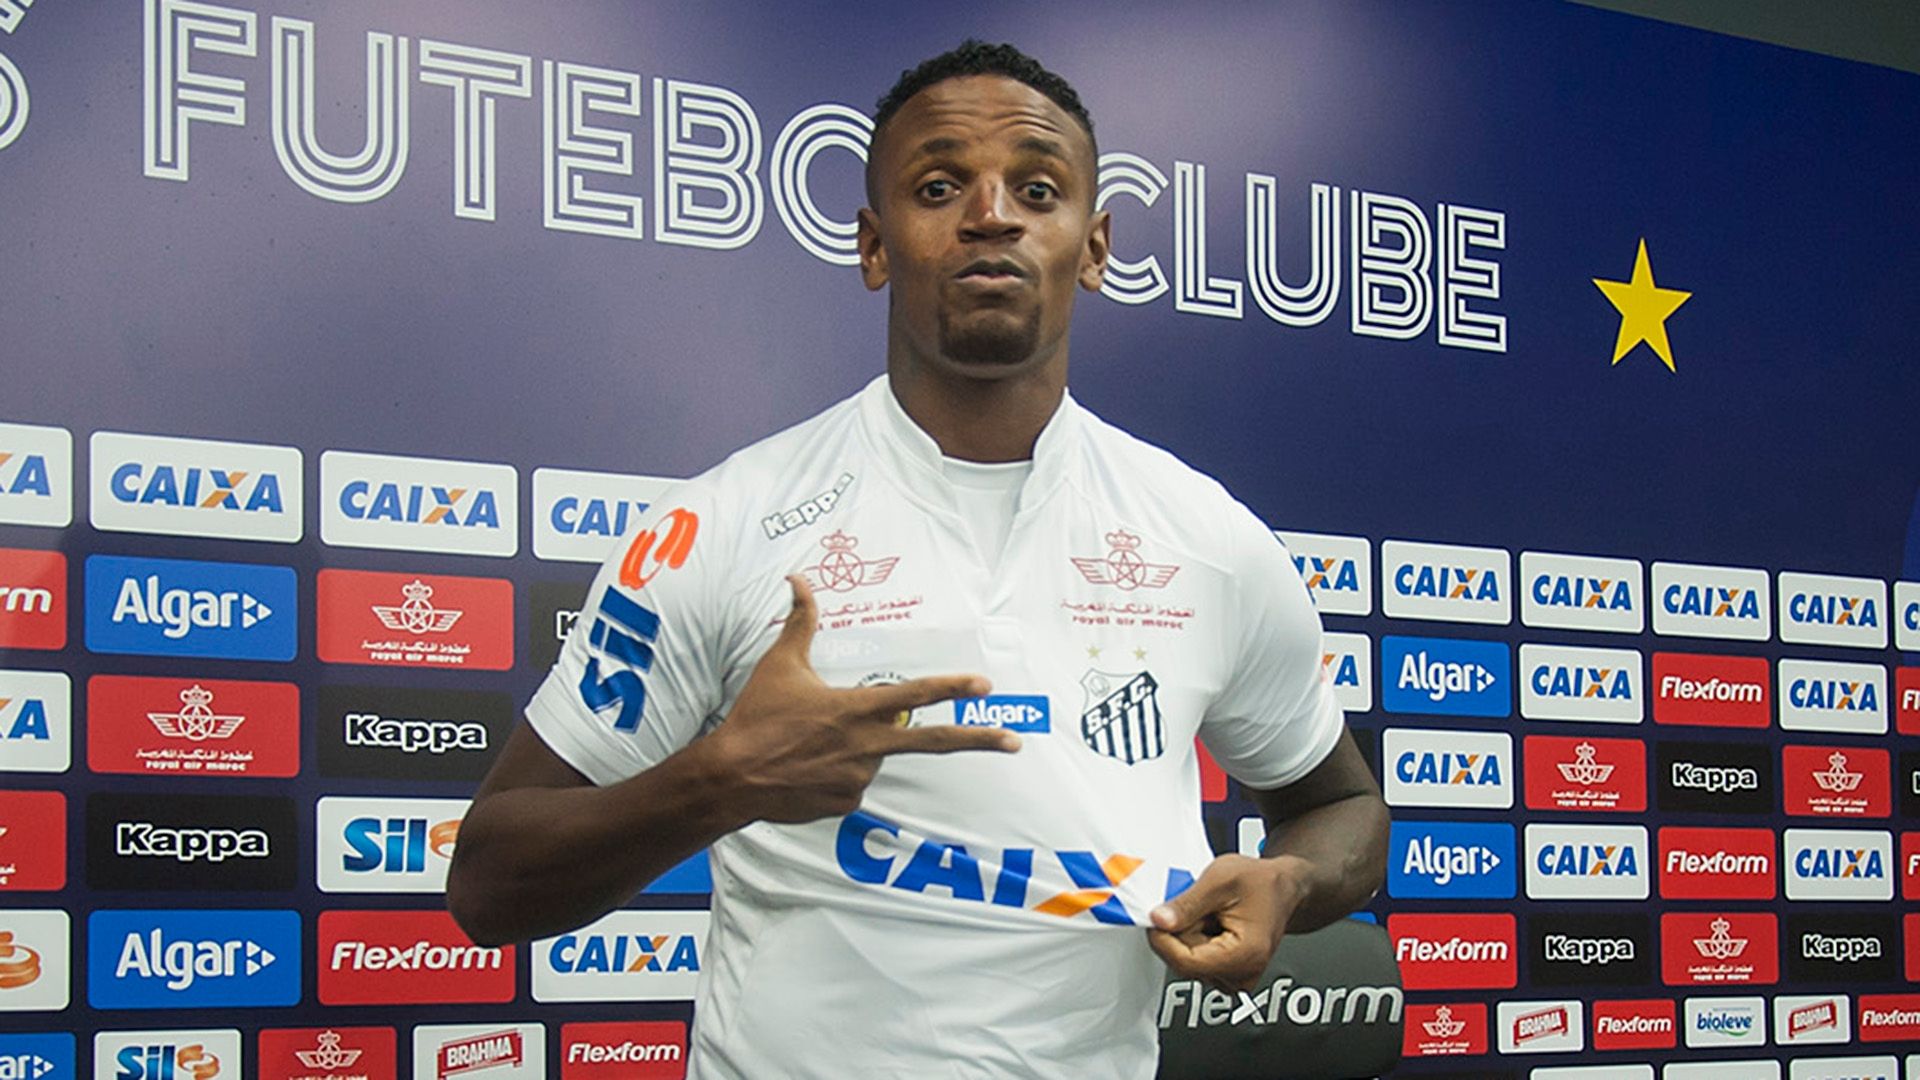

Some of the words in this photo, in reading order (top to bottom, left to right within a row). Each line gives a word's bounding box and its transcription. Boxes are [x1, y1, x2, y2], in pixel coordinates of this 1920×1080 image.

[144, 0, 876, 266] FUTEBO
[1097, 152, 1507, 353] CLUBE
[111, 463, 283, 513] CAIXA
[339, 480, 499, 529] CAIXA
[551, 497, 649, 537] CAI
[1395, 564, 1500, 602] CAIXA
[1532, 574, 1632, 611] CAIXA
[112, 575, 239, 638] Algar
[1663, 584, 1760, 619] CAIXA
[1789, 593, 1878, 628] CAIXA
[579, 584, 661, 734] Sil
[1398, 651, 1473, 701] Algar
[1532, 665, 1632, 700] CAIXA
[1661, 676, 1762, 702] Flexform
[1789, 679, 1878, 712] CAIXA
[961, 699, 1026, 728] Algar
[345, 714, 488, 754] Kappa
[1396, 751, 1502, 786] CAIXA
[1672, 762, 1758, 793] Kappa
[116, 823, 270, 862] Kappa
[343, 818, 427, 873] Sil
[1403, 836, 1480, 885] Algar
[1537, 844, 1639, 877] CAIXA
[1666, 850, 1768, 874] Flexform
[1795, 848, 1884, 879] CAIXA
[116, 928, 243, 990] Algar
[331, 941, 502, 970] Flexform
[549, 935, 699, 974] CAIXA
[1396, 937, 1508, 961] Flexform
[1545, 935, 1635, 963] Kappa
[1802, 934, 1881, 962] Kappa
[1159, 978, 1403, 1028] Flexform
[1597, 1016, 1672, 1034] Flexform
[1697, 1013, 1752, 1030] bioleve
[117, 1045, 175, 1080] Sil
[446, 1036, 513, 1068] BRAHMA
[568, 1041, 680, 1063] Flexform
